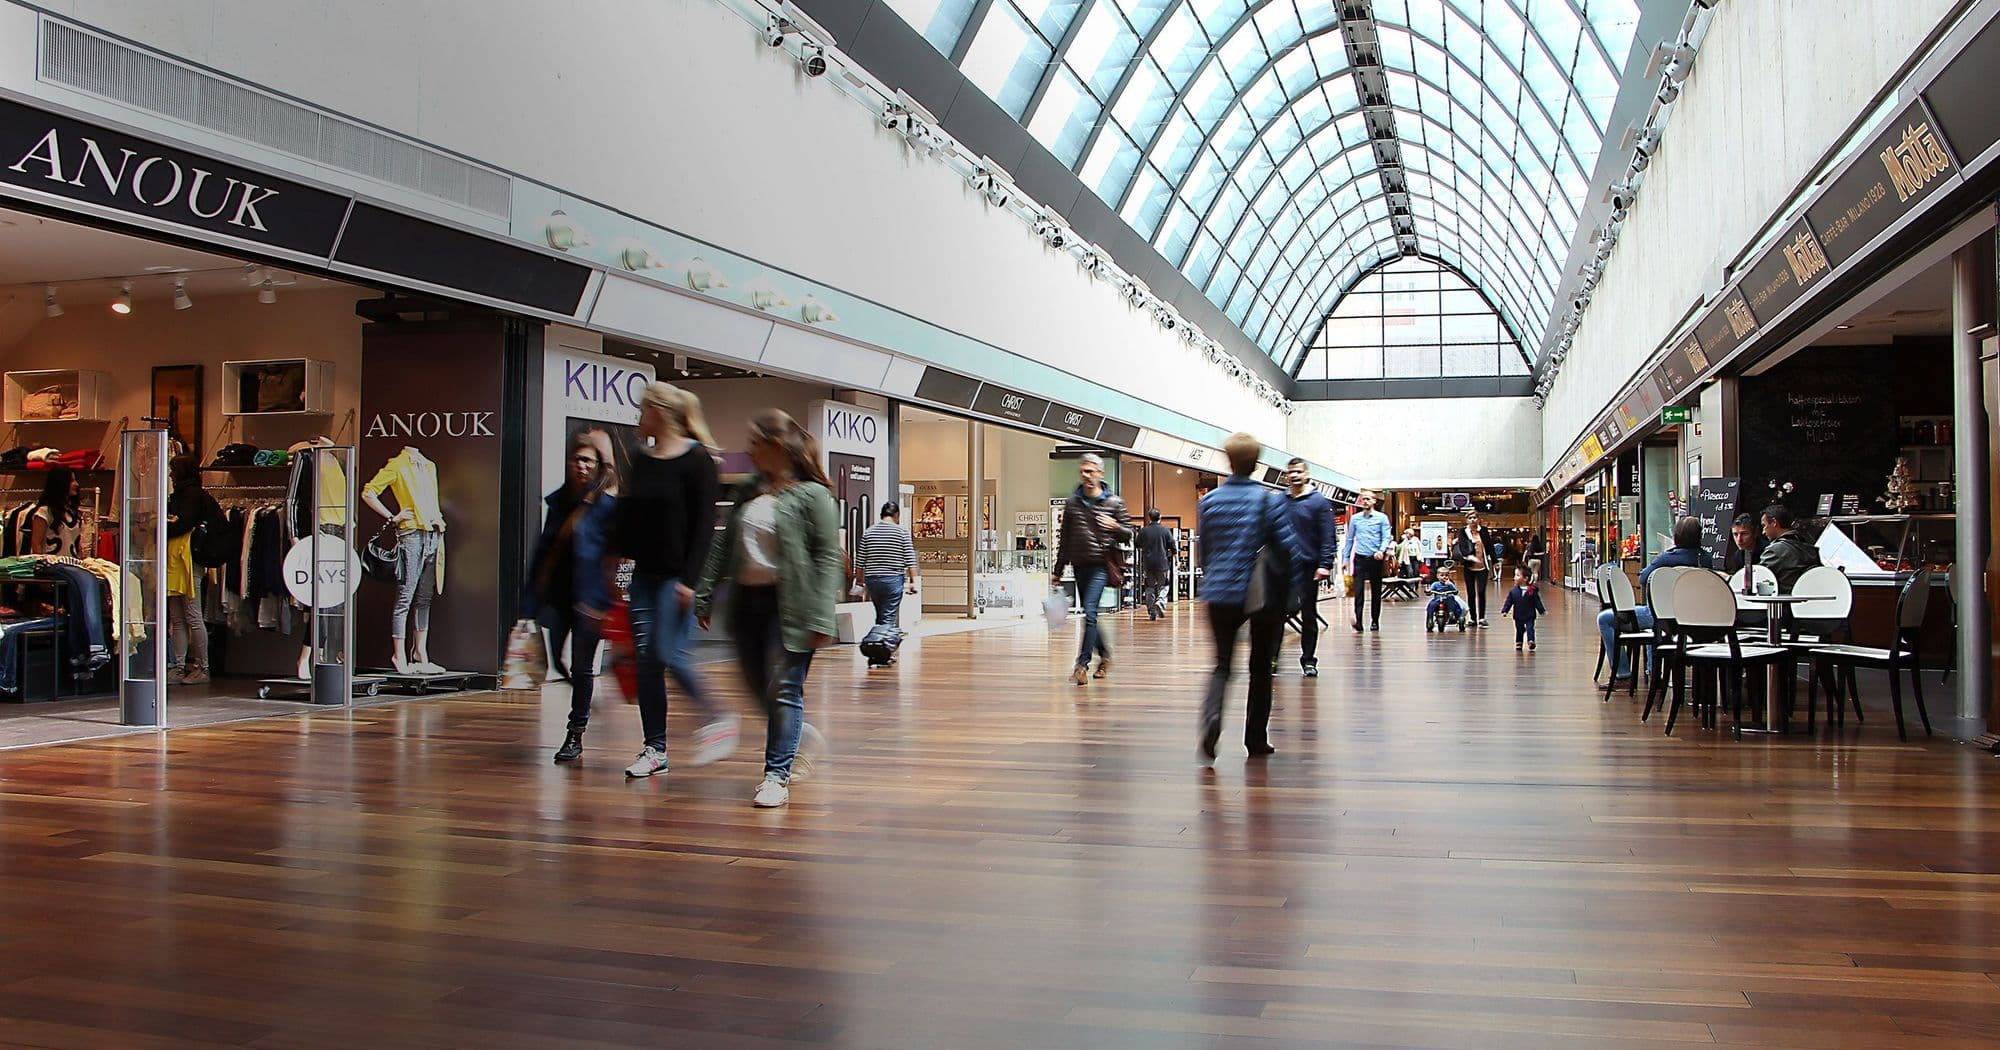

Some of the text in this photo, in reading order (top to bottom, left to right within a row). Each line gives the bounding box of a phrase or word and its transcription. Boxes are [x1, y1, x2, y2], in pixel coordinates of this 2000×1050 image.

[1880, 122, 1949, 203] Motta
[8, 128, 280, 232] ANOUK
[1866, 182, 1886, 206] 1928
[1783, 232, 1826, 286] Motta
[565, 359, 650, 409] KIKO
[1001, 393, 1025, 411] CHRIST
[365, 412, 495, 437] ANOUK
[828, 409, 876, 443] KIKO
[1064, 411, 1084, 427] CHRIST
[1018, 514, 1044, 522] CHRIST
